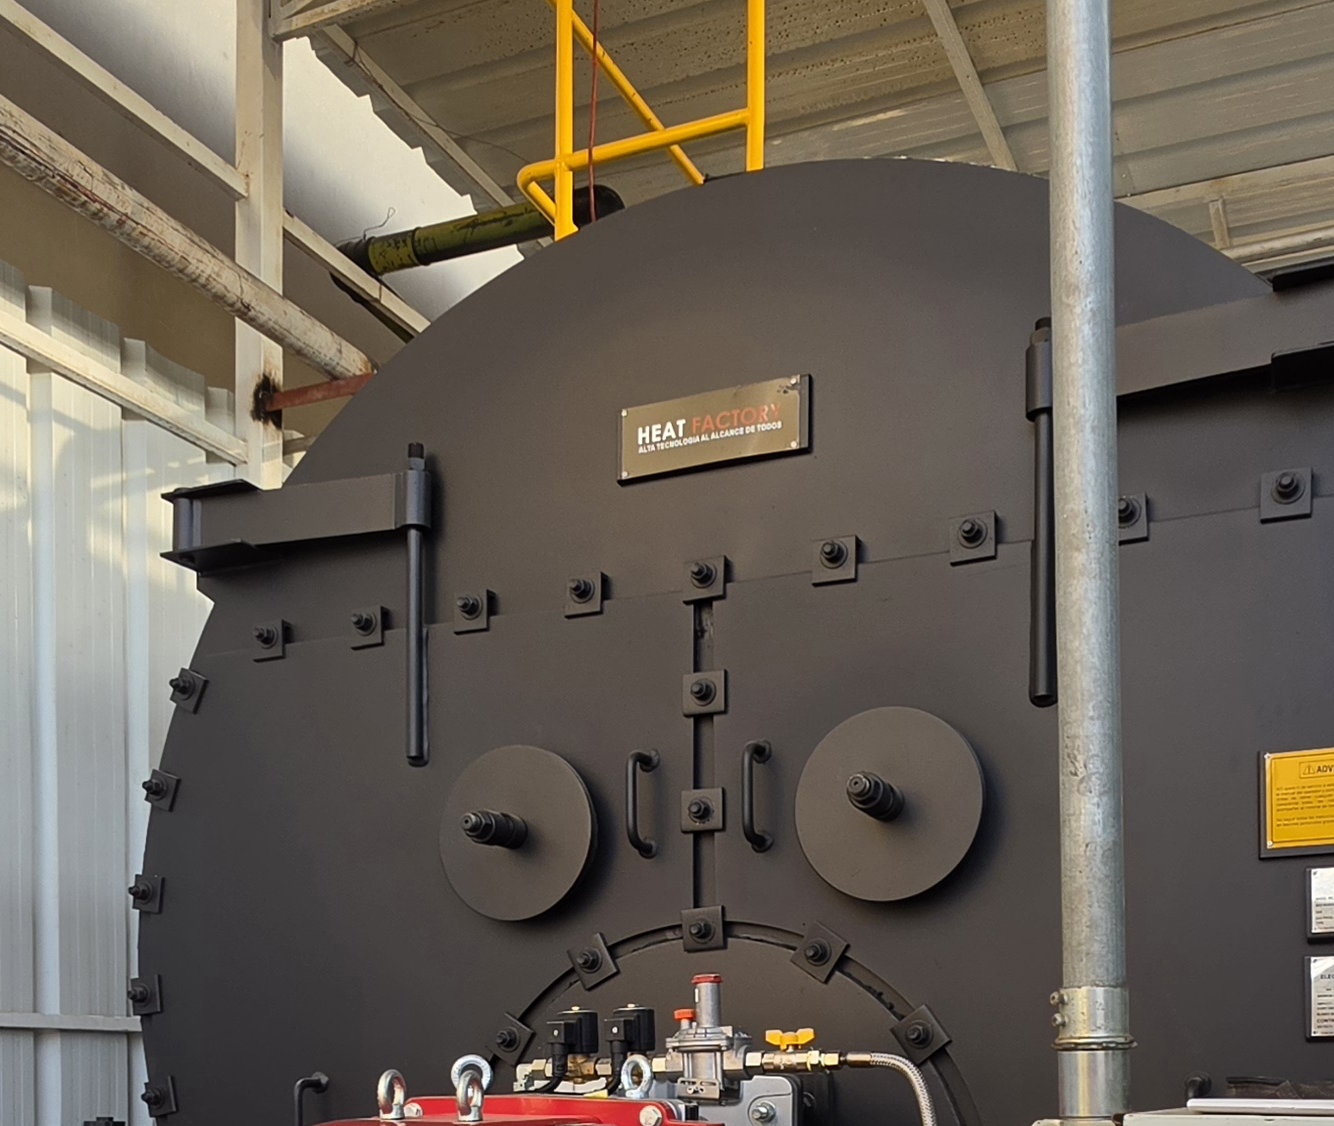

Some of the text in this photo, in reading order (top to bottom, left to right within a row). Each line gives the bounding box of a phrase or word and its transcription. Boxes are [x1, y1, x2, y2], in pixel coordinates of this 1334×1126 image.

[638, 403, 782, 445] HEAT FACTORY
[638, 420, 783, 454] ALTA TECNOLOGIA AL ALCANCE DE TODOS
